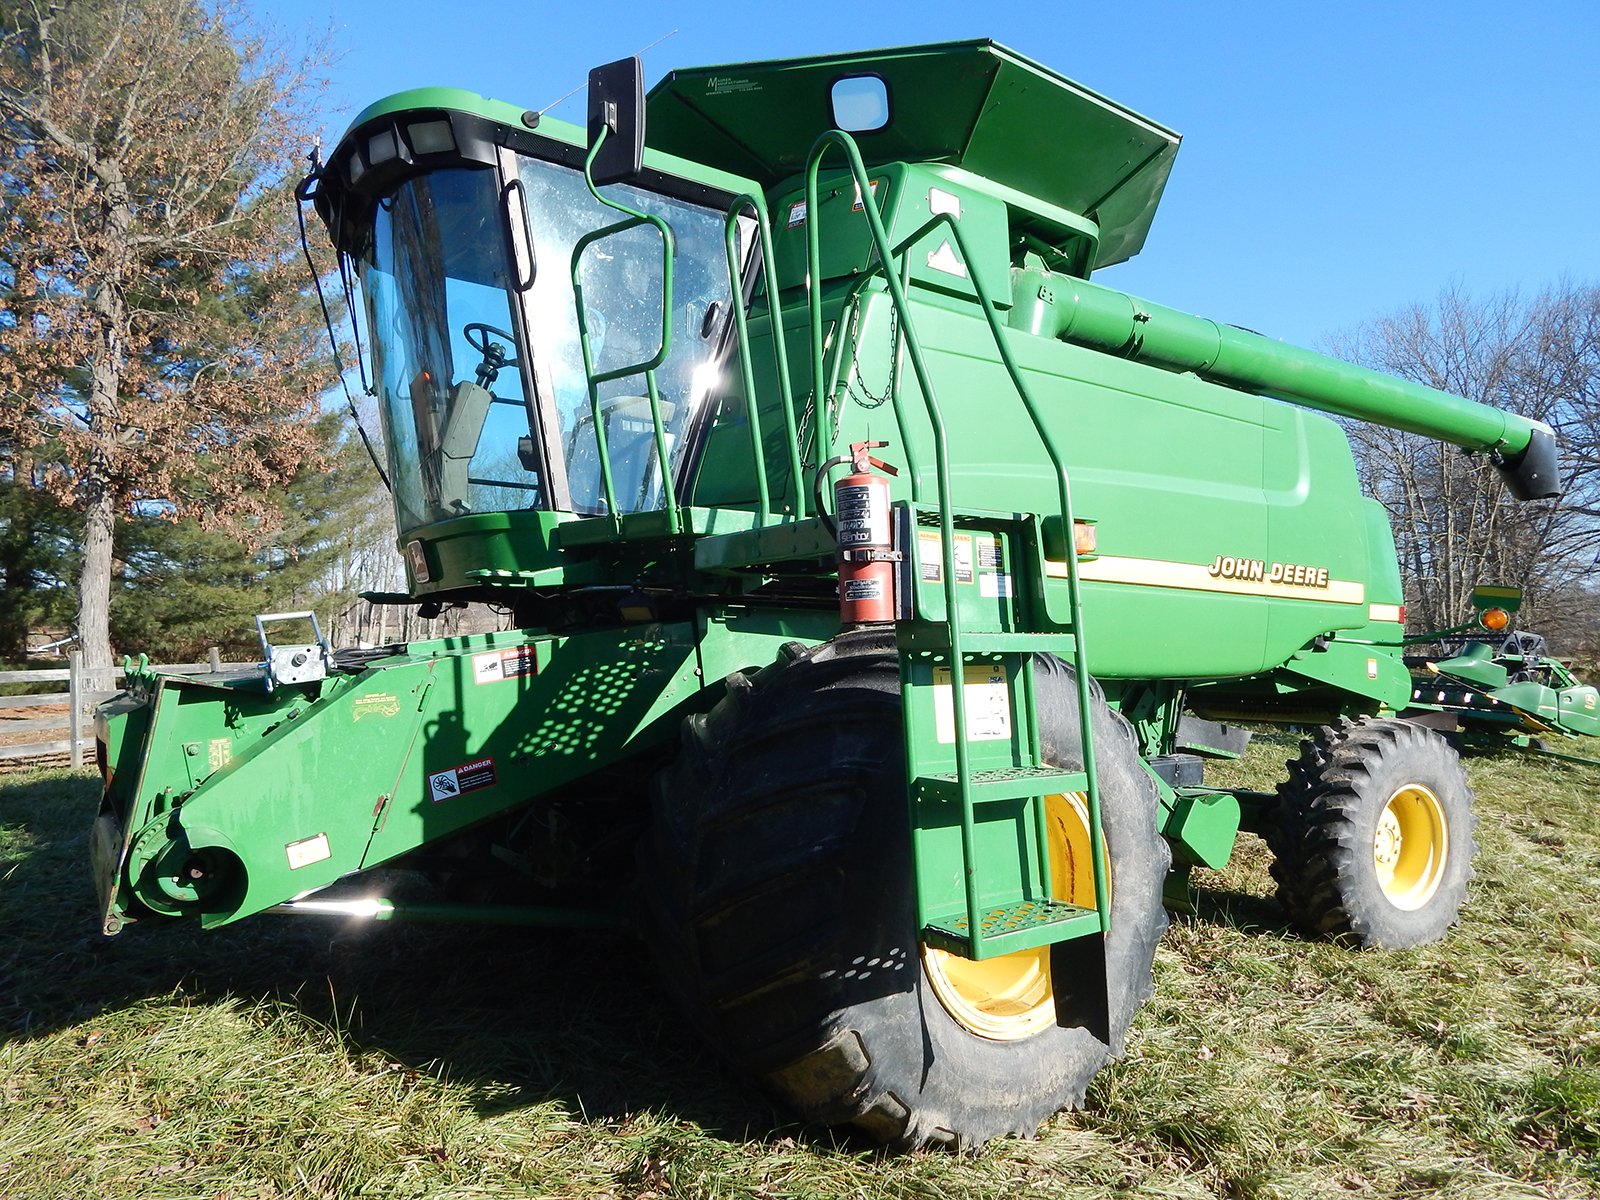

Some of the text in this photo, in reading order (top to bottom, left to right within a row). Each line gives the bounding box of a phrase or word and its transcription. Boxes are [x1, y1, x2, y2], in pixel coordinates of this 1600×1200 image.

[841, 531, 869, 542] sentry
[1208, 555, 1328, 588] JOHN DEERE
[463, 760, 492, 772] DANGER
